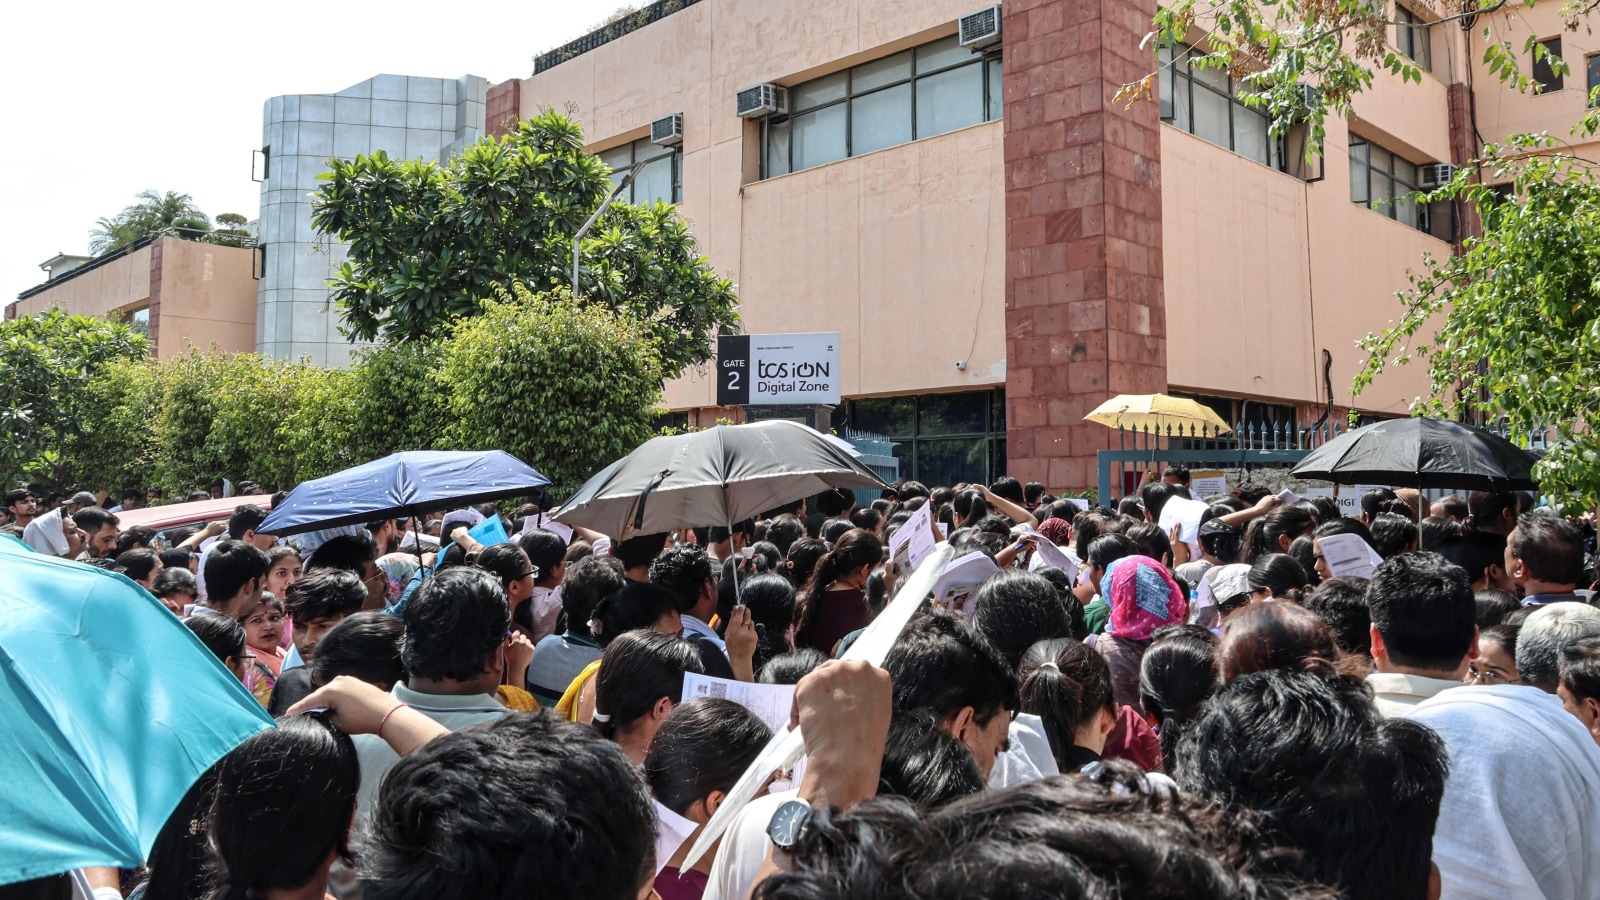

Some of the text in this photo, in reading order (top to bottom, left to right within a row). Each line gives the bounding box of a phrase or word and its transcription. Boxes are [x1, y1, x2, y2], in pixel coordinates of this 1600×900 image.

[723, 359, 745, 368] GATE
[792, 361, 830, 378] iON
[727, 371, 740, 390] 2
[757, 380, 829, 396] Digital Zone
